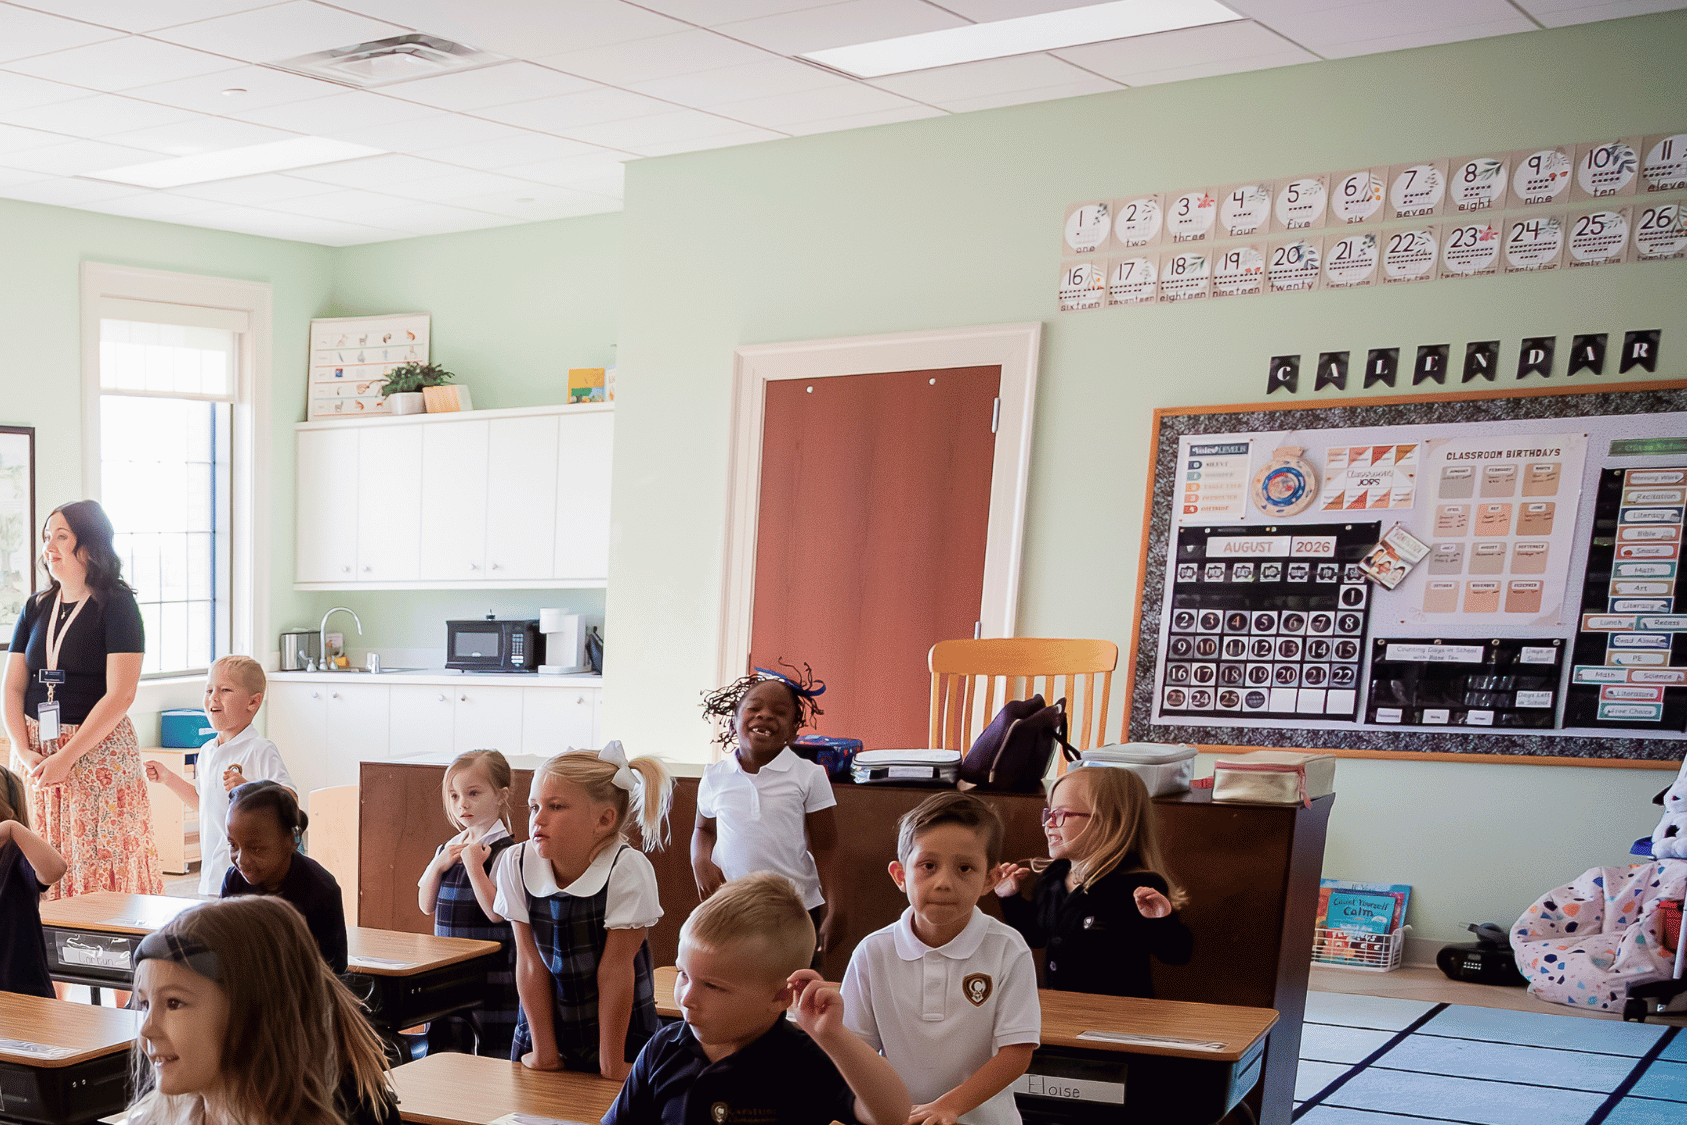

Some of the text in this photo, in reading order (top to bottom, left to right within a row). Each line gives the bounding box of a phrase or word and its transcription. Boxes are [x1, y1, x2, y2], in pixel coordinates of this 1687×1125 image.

[1587, 147, 1610, 169] 10
[1661, 139, 1673, 161] 11
[1464, 163, 1477, 183] 8
[1528, 155, 1542, 176] 9
[1344, 177, 1357, 197] 6
[1404, 170, 1418, 190] 7
[1647, 178, 1687, 193] eleve
[1233, 191, 1245, 209] 4
[1287, 183, 1300, 203] 5
[1525, 194, 1553, 206] nine
[1593, 186, 1616, 199] ten
[1126, 204, 1137, 222] 2
[1178, 198, 1190, 216] 3
[1396, 207, 1434, 218] seven
[1458, 198, 1492, 212] eight
[1079, 210, 1083, 227] 1
[1286, 218, 1311, 230] five
[1347, 214, 1364, 224] six
[1575, 214, 1606, 237] 25
[1640, 206, 1673, 230] 26
[1173, 232, 1206, 243] three
[1229, 226, 1257, 237] four
[1450, 227, 1478, 248] 23
[1511, 220, 1539, 243] 24
[1076, 245, 1095, 253] one
[1126, 239, 1147, 248] two
[1335, 241, 1353, 260] 21
[1389, 233, 1415, 254] 22
[1223, 252, 1241, 271] 19
[1273, 247, 1301, 266] 20
[1118, 262, 1135, 281] 17
[1170, 257, 1187, 275] 18
[1067, 268, 1083, 286] 16
[1212, 287, 1260, 298] nineteen
[1269, 281, 1314, 293] twenty
[1108, 295, 1155, 307] seventeen
[1159, 291, 1207, 303] eighteen
[1060, 301, 1101, 312] sixteen
[1277, 342, 1649, 381] CALENDAR
[1446, 448, 1561, 461] CLASSROOM BIRTHDAYS
[1224, 541, 1330, 553] AUGUST 2026
[1350, 590, 1355, 602] 1
[1180, 612, 1354, 630] 2 3 4 5 6 7 8
[1177, 641, 1354, 656] 9 10 11 12 13 14 15
[1171, 667, 1351, 683] 16 17 18 19 20 21 22
[1191, 694, 1209, 706] 24
[1219, 694, 1238, 706] 25
[1343, 907, 1374, 917] Calm
[1028, 1075, 1081, 1099] Eloise
